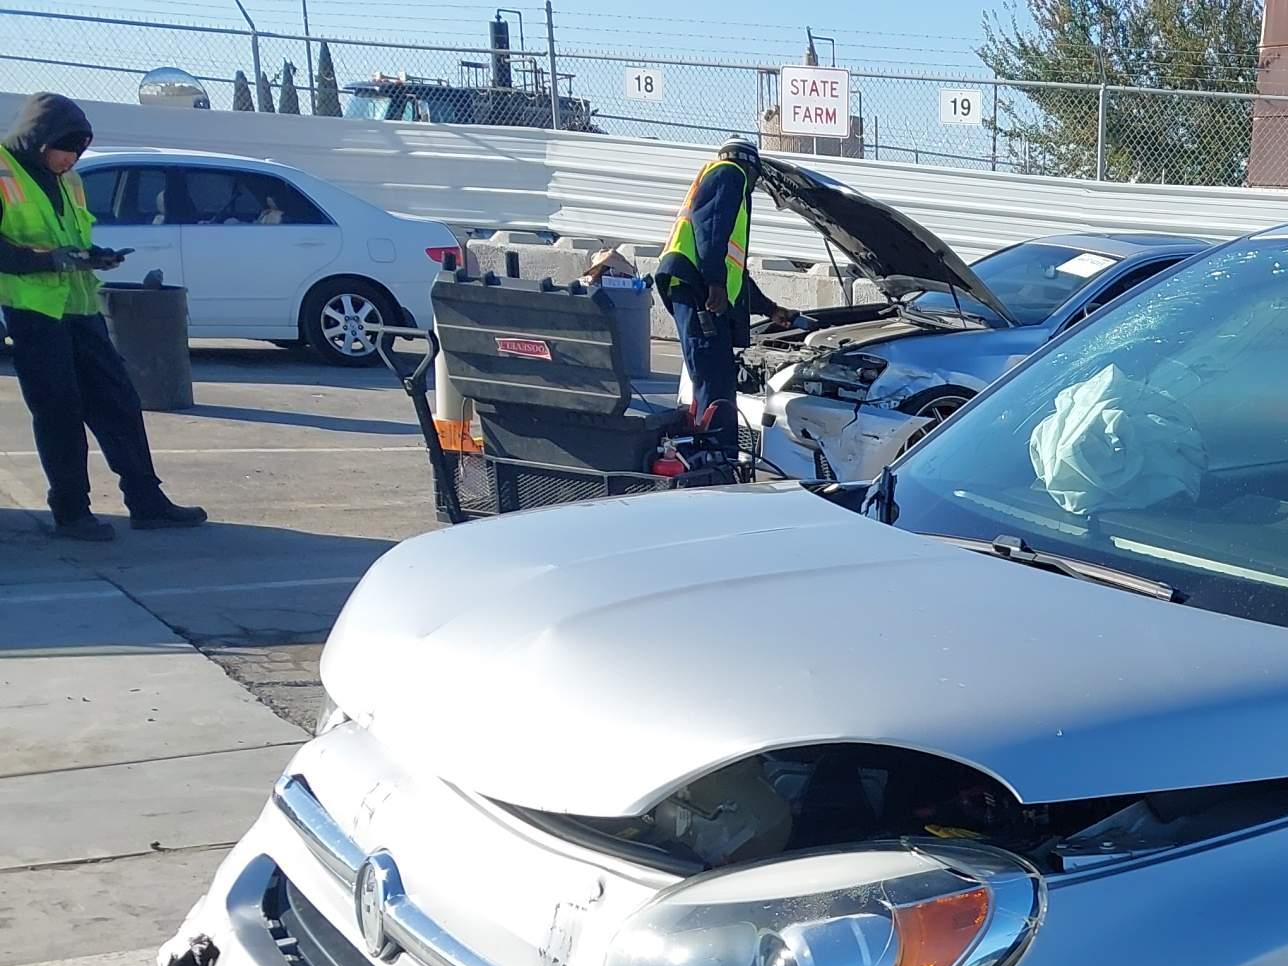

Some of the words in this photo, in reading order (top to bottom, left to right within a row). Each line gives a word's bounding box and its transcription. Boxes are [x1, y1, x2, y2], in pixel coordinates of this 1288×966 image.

[633, 75, 655, 94] 18
[790, 78, 840, 98] STATE
[792, 105, 838, 125] FARM
[950, 97, 972, 117] 19
